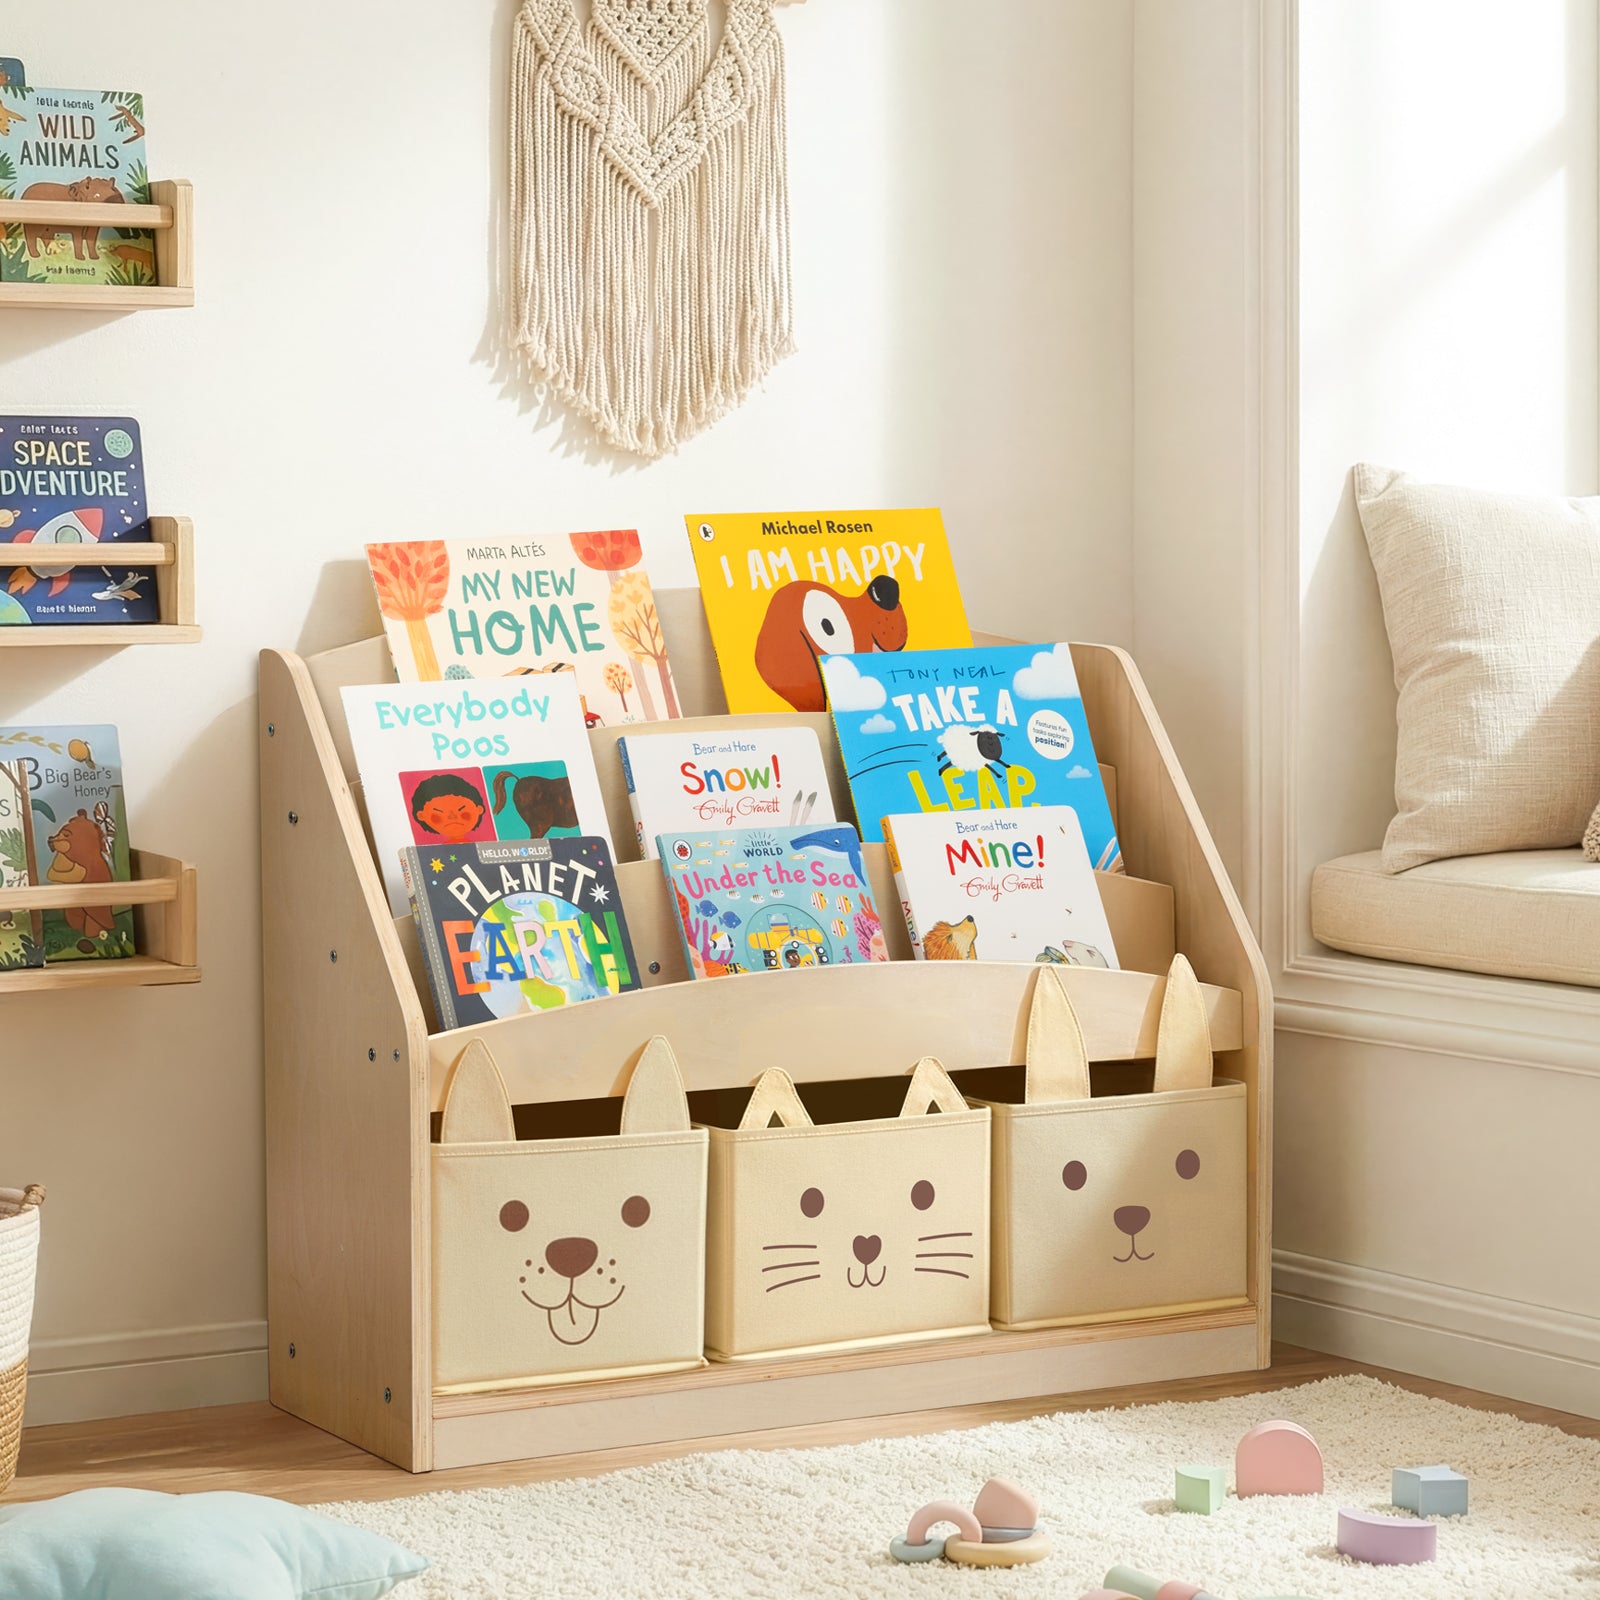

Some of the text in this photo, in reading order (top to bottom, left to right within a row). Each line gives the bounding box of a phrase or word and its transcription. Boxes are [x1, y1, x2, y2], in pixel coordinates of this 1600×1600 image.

[38, 113, 95, 140] WILD
[20, 141, 120, 169] ANIMALS
[14, 440, 92, 466] SPACE
[0, 469, 129, 496] DVENTURE
[761, 520, 873, 536] Michael Rosen
[467, 541, 546, 560] MARTA ALTÉS
[719, 541, 925, 590] I AM HAPPY
[461, 567, 576, 604] MY NEW
[448, 602, 605, 656] HOME
[887, 665, 1006, 683] TONY NEAL
[375, 688, 550, 730] Everybody
[891, 685, 1018, 733] TAKE A
[431, 732, 510, 760] Poos
[693, 741, 756, 756] Bear and Hare
[45, 767, 112, 788] Big Bear's
[680, 754, 781, 795] Snow!
[75, 785, 111, 798] Honey
[693, 799, 736, 825] Emily
[955, 819, 1018, 834] Bear and Hare
[481, 848, 512, 858] HELLO,
[743, 847, 783, 858] WORLD
[751, 840, 772, 848] little
[945, 834, 1045, 876] Mine!
[447, 859, 597, 917] PLANET
[682, 860, 859, 899] Under the Sea
[960, 877, 1002, 902] Emily
[442, 911, 632, 996] EARTH
